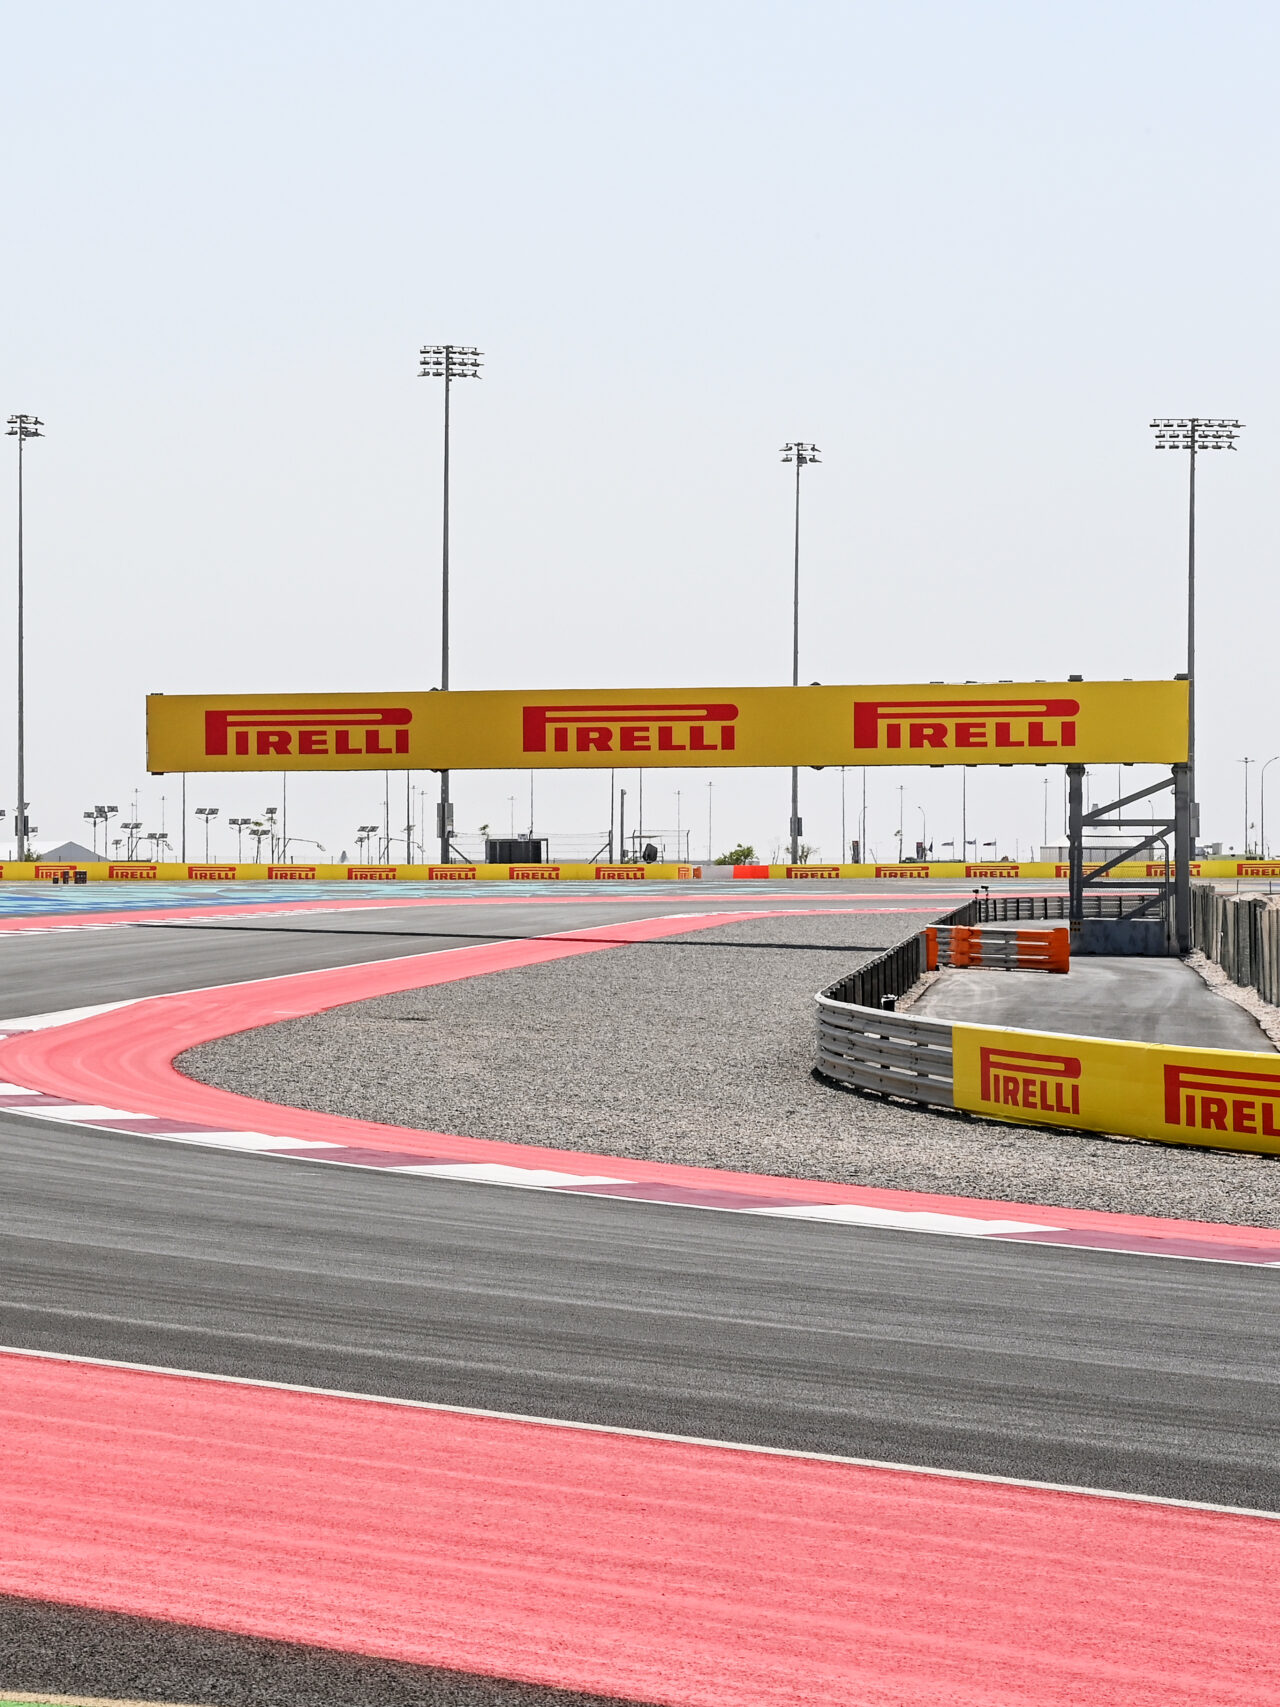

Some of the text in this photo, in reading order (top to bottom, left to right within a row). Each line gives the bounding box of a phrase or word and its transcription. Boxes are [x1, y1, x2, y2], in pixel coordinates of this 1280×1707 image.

[523, 704, 739, 752] PIRELLI
[854, 699, 1080, 748] PIRELLI
[205, 708, 413, 755] PIRELLI
[109, 866, 157, 879] PIRELLI
[188, 867, 237, 880] PIRELLI
[268, 867, 316, 880] PIRELLI
[347, 868, 397, 880] PIRELLI
[428, 868, 477, 880] PIRELLI
[509, 867, 561, 880] PIRELLI
[595, 867, 645, 880] PIRELLI
[786, 866, 840, 879] PIRELLI
[875, 866, 930, 879] PIRELLI
[965, 865, 1020, 878] PIRELLI
[1237, 863, 1280, 876] PIREL
[980, 1047, 1081, 1114] PIRELLI
